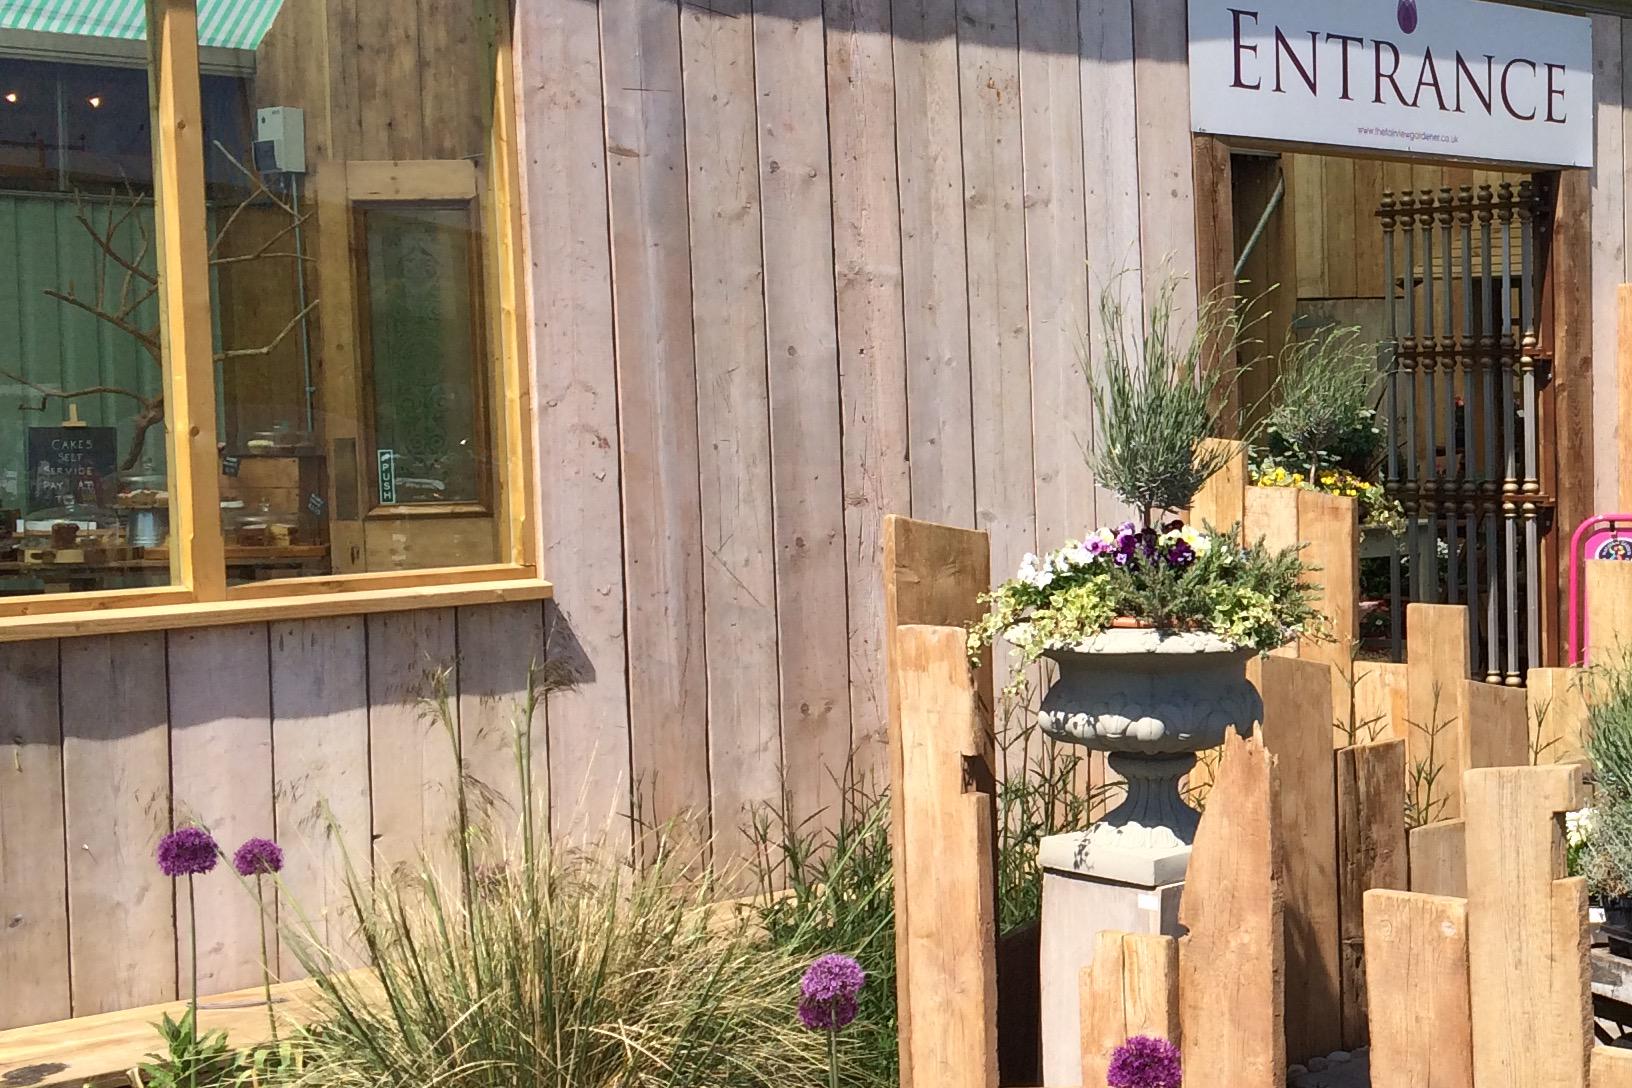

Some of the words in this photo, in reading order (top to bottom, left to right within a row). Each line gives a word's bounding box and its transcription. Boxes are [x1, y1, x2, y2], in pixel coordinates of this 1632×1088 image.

[1226, 7, 1567, 124] ENTRANCE
[51, 439, 93, 450] CAKES
[43, 480, 63, 490] PAY
[382, 463, 391, 500] PUSH
